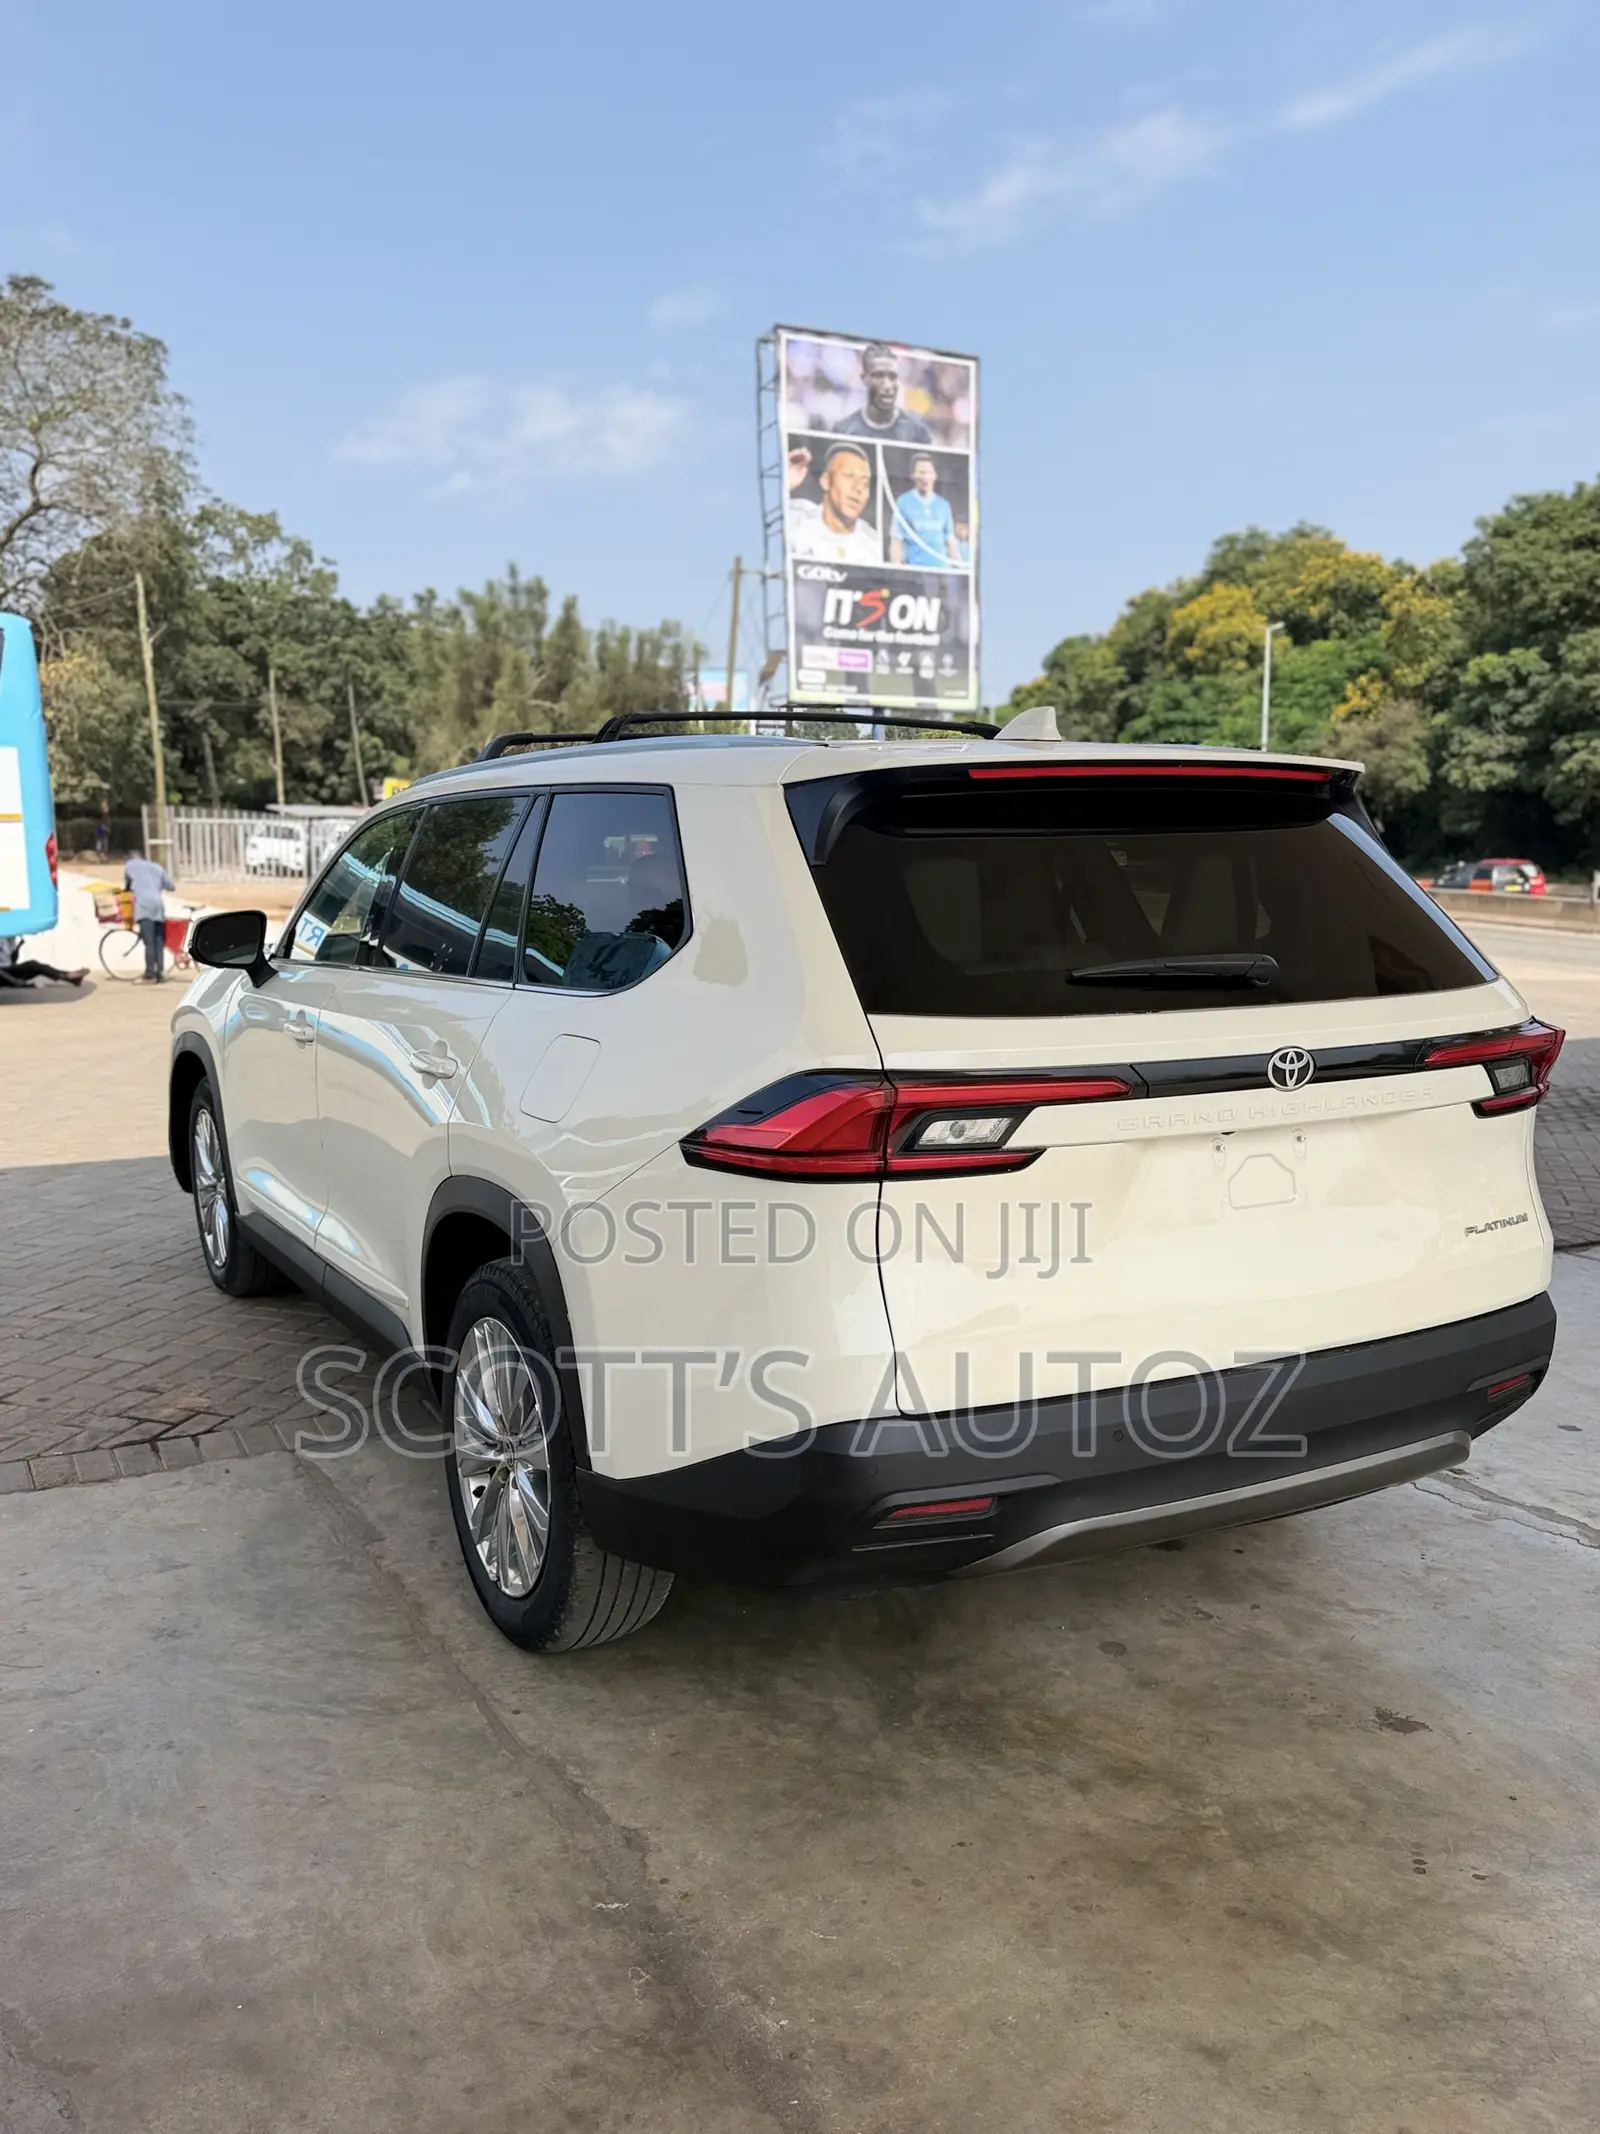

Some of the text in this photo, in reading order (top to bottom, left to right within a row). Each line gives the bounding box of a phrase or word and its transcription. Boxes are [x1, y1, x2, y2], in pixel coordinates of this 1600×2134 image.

[889, 593, 941, 632] ON
[1117, 1087, 1434, 1131] GRAND HIGHLANDER
[1464, 1212, 1528, 1237] PLATINUM
